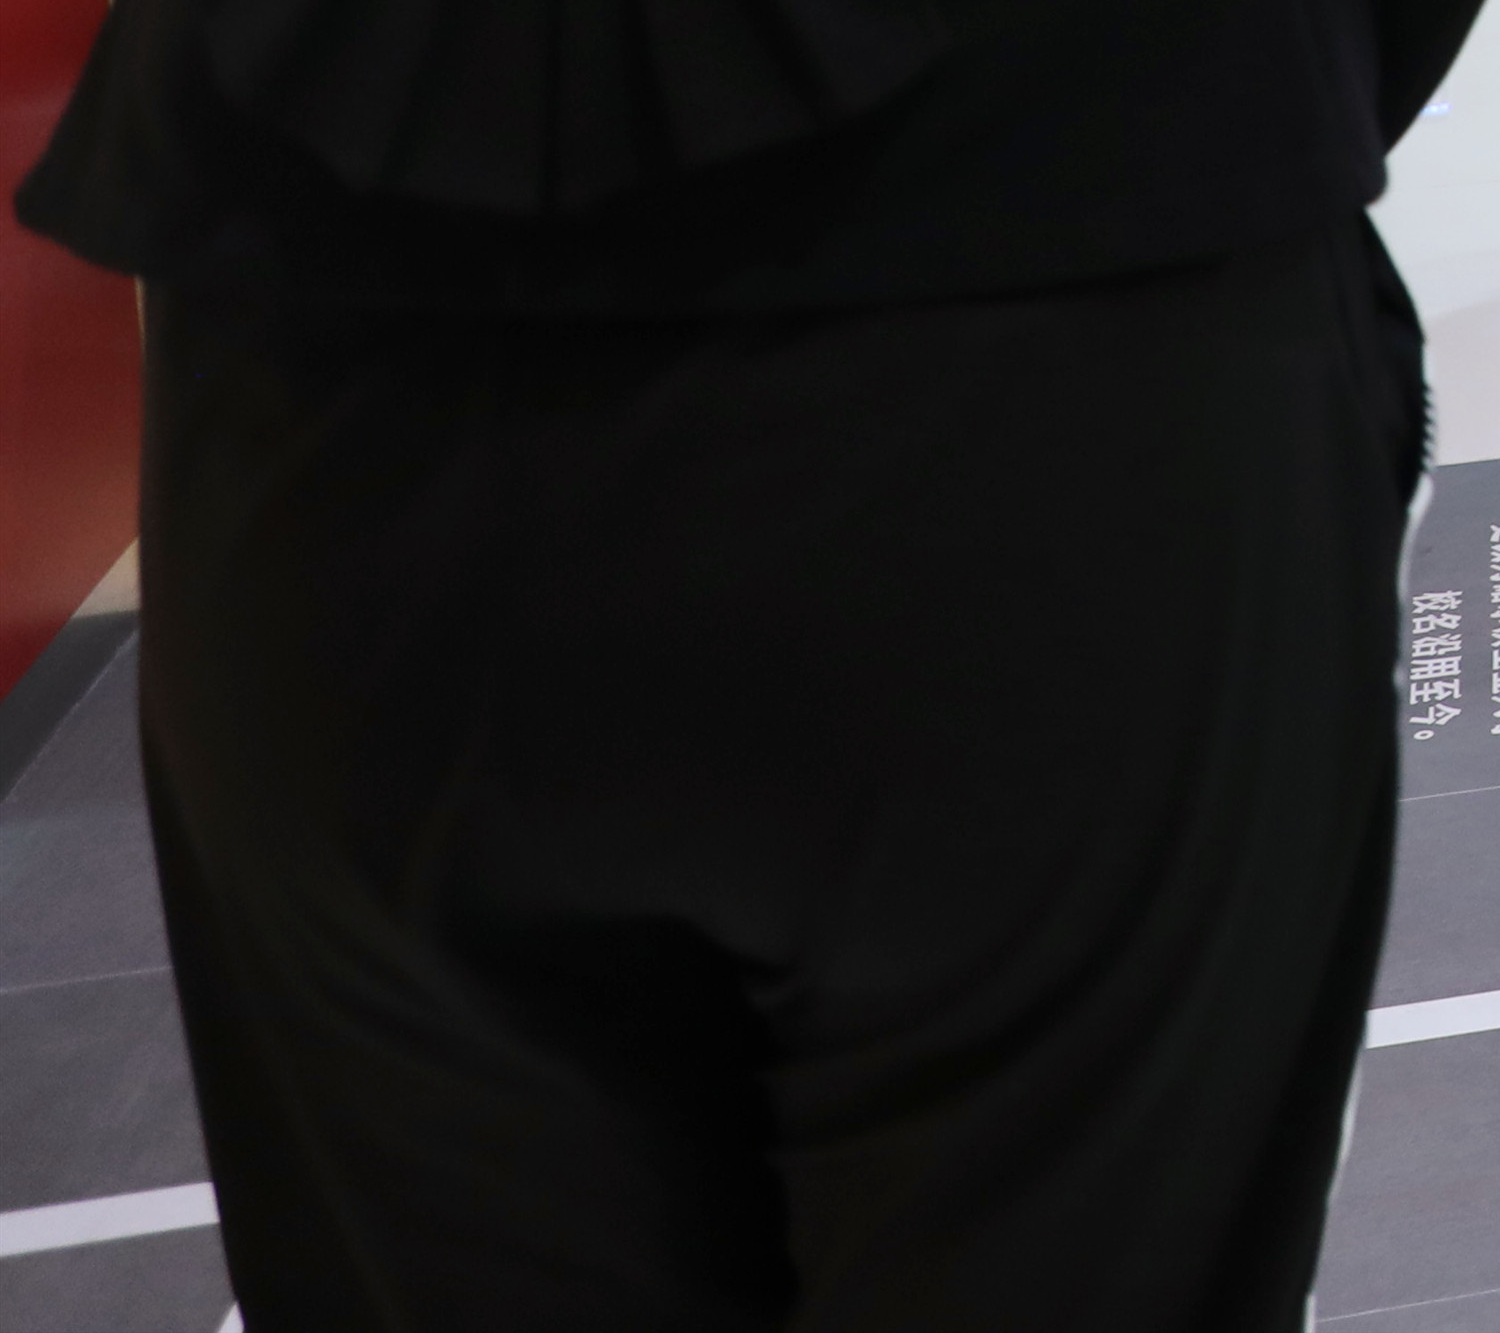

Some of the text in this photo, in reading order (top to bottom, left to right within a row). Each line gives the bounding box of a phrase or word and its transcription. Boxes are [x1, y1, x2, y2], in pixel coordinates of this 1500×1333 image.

[1409, 590, 1463, 741] 校名沿用至今。
